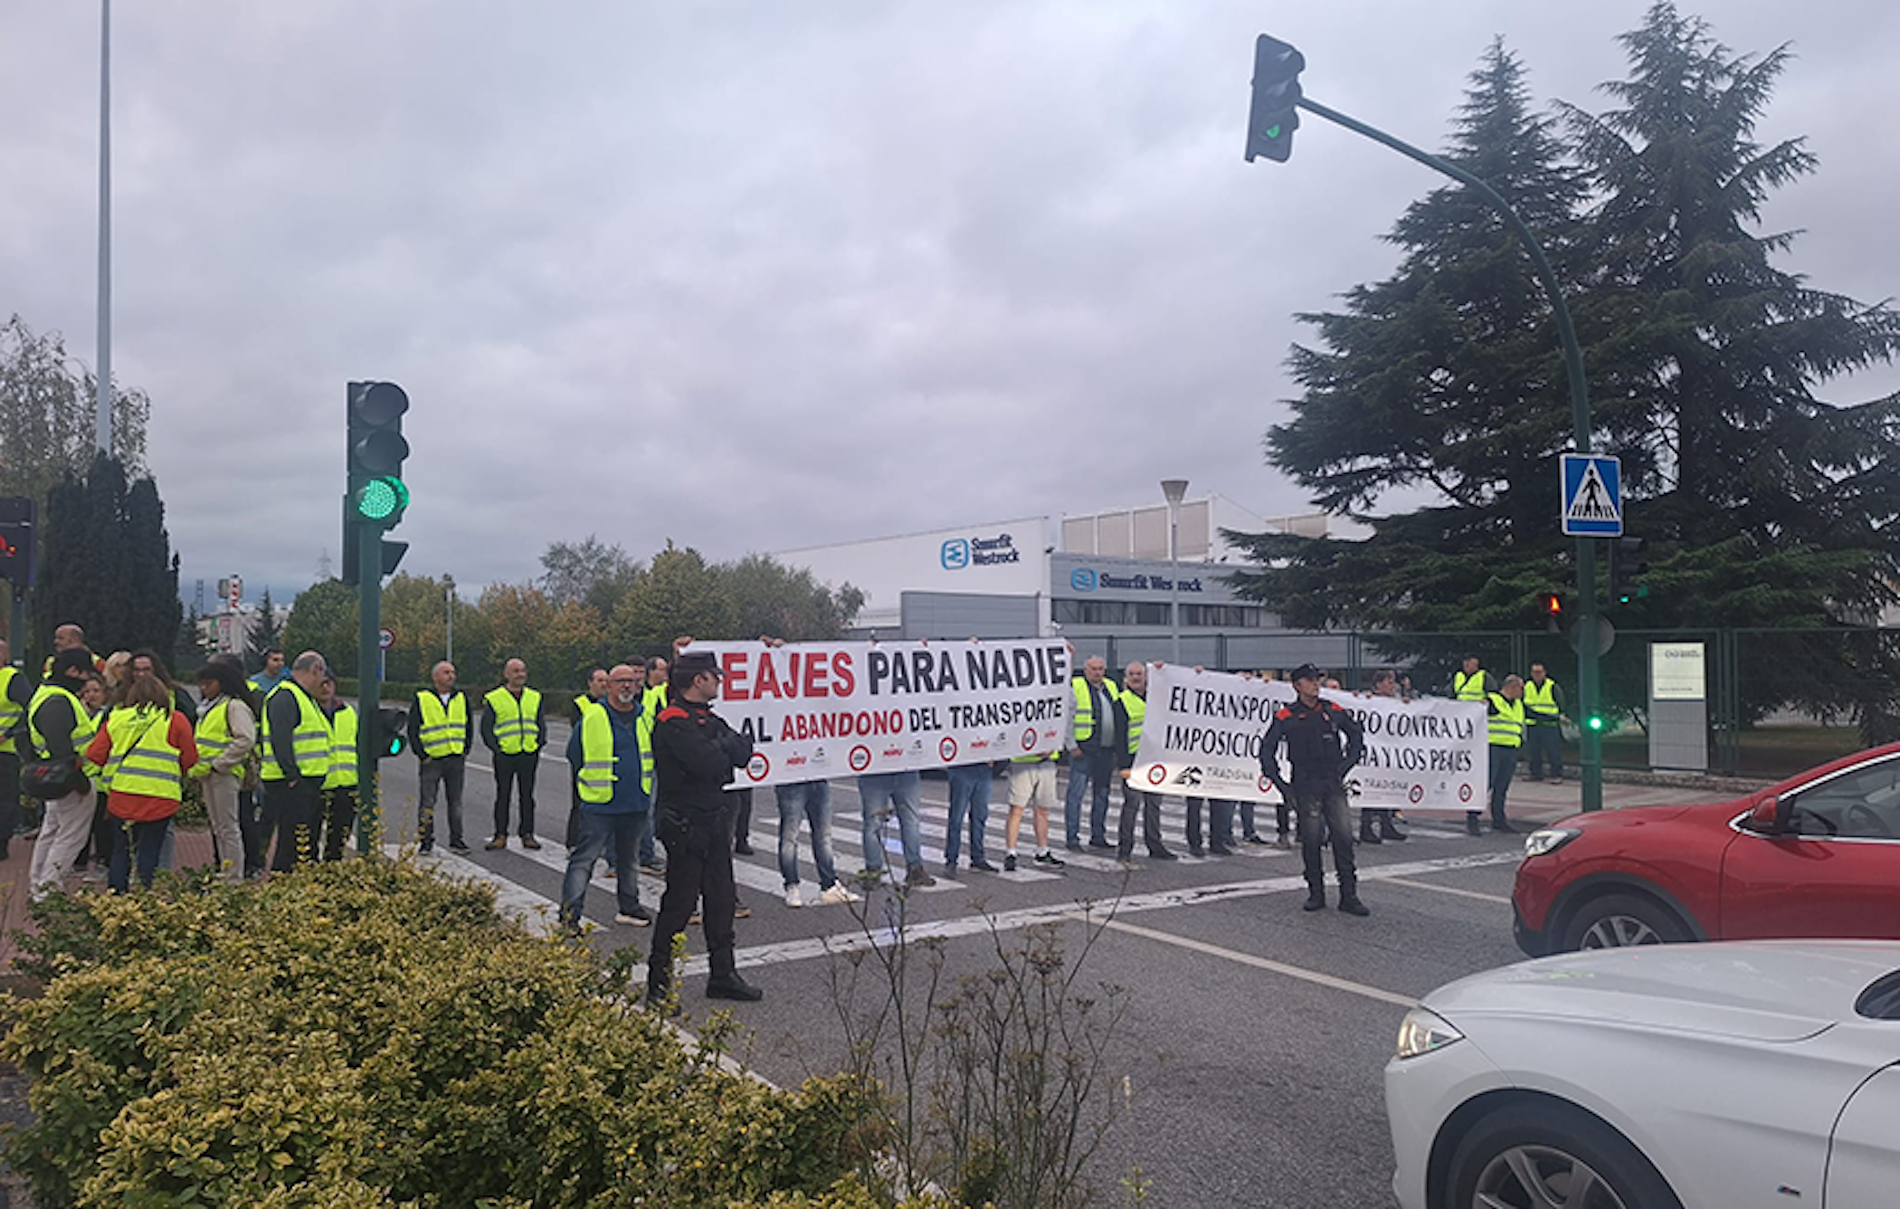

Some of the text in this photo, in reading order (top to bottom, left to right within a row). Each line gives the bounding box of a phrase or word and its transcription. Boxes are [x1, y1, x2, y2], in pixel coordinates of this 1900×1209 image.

[1150, 576, 1203, 592] Wesrock
[722, 647, 1066, 701] EAJES PARA NADIE
[781, 708, 904, 742] ABANDONO
[909, 706, 942, 732] DEL
[949, 697, 1062, 730] TRANSPORTE
[1169, 686, 1281, 723] EL TRANSPO
[1164, 724, 1262, 758] IMPOSICIÓ
[1386, 713, 1452, 738] CONTRA
[1455, 717, 1473, 739] LA
[1381, 746, 1392, 768] Y
[1394, 747, 1426, 771] LOS
[1430, 748, 1472, 774] PEAJES
